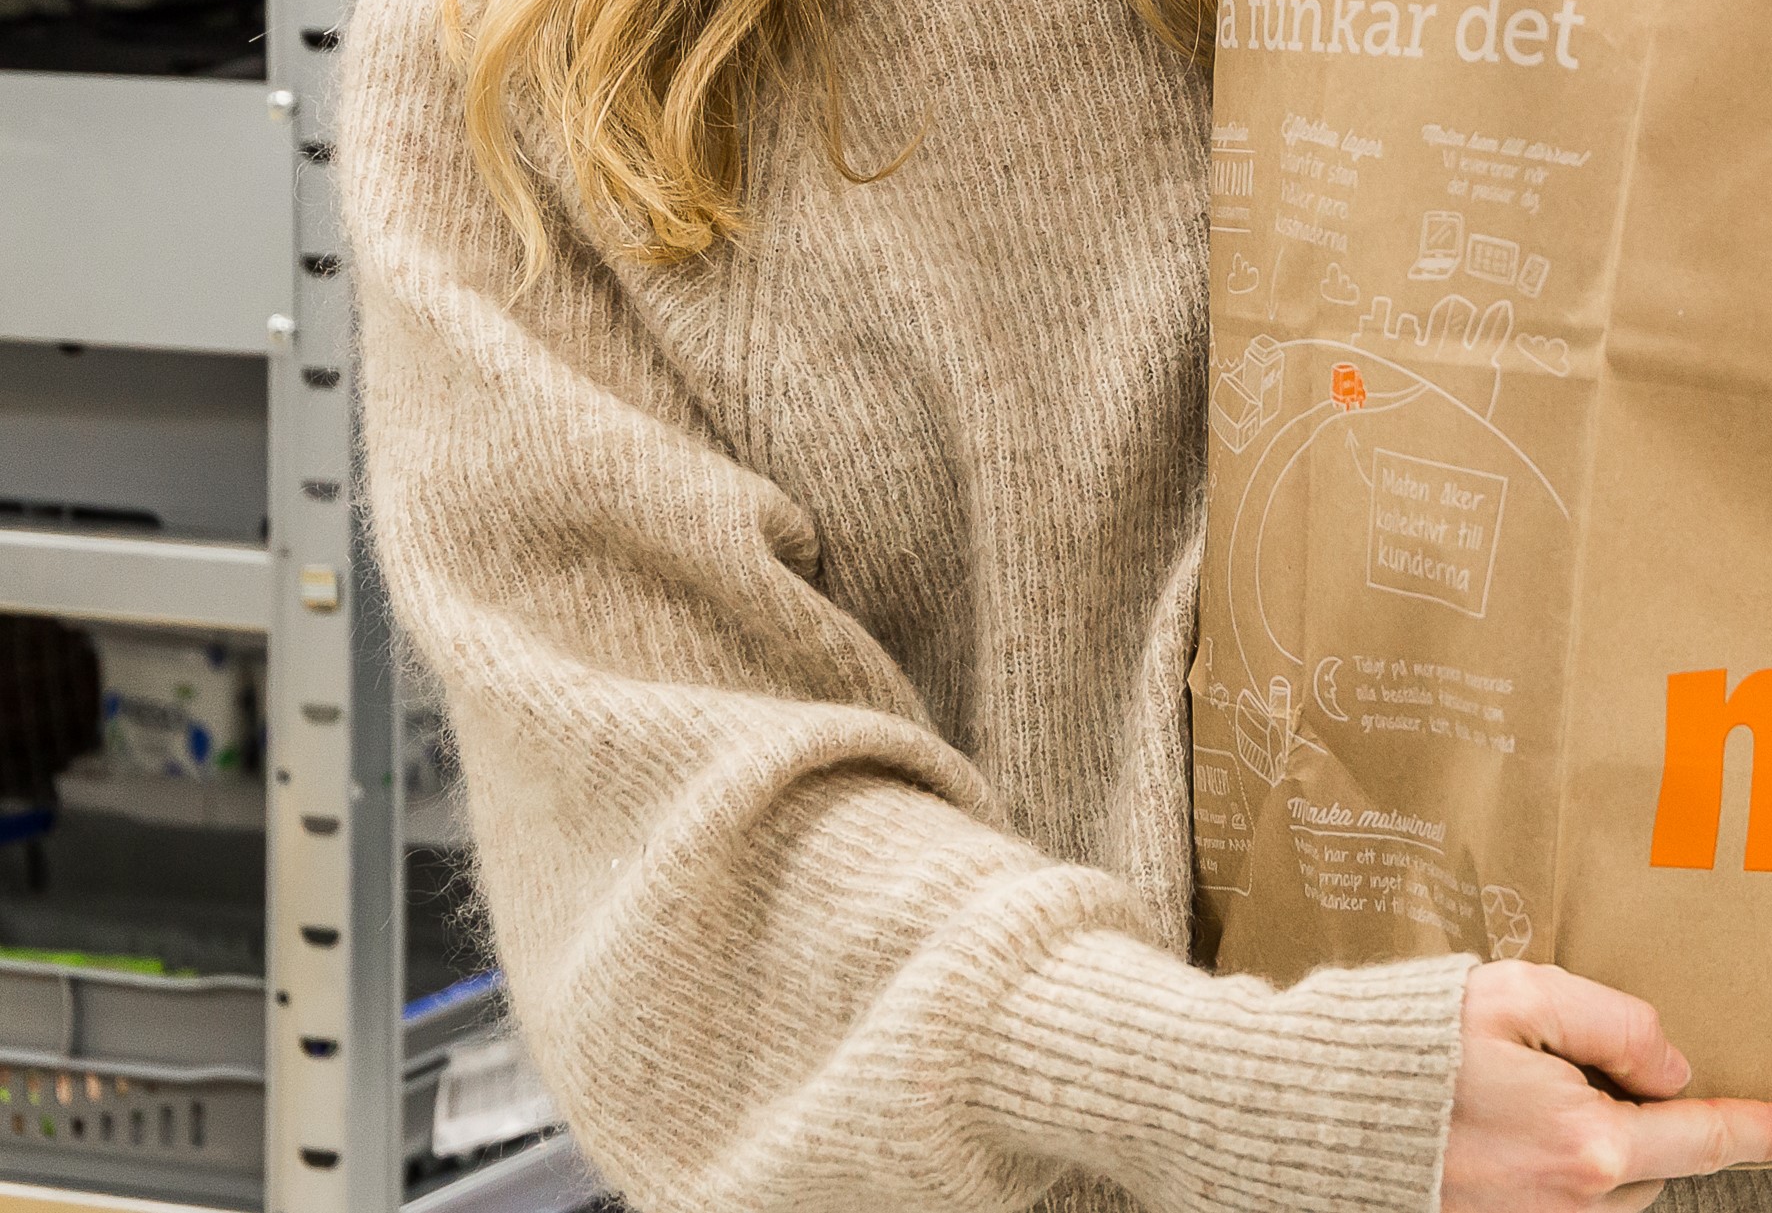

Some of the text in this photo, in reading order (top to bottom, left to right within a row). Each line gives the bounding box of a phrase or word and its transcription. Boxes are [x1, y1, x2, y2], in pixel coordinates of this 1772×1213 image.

[1382, 468, 1430, 502] Maten
[1457, 522, 1484, 551] till
[1378, 536, 1470, 593] kunderna
[1287, 797, 1353, 826] Minska
[1324, 845, 1349, 863] har
[1357, 848, 1376, 865] ett
[1318, 870, 1363, 892] princip
[1374, 895, 1387, 912] vi
